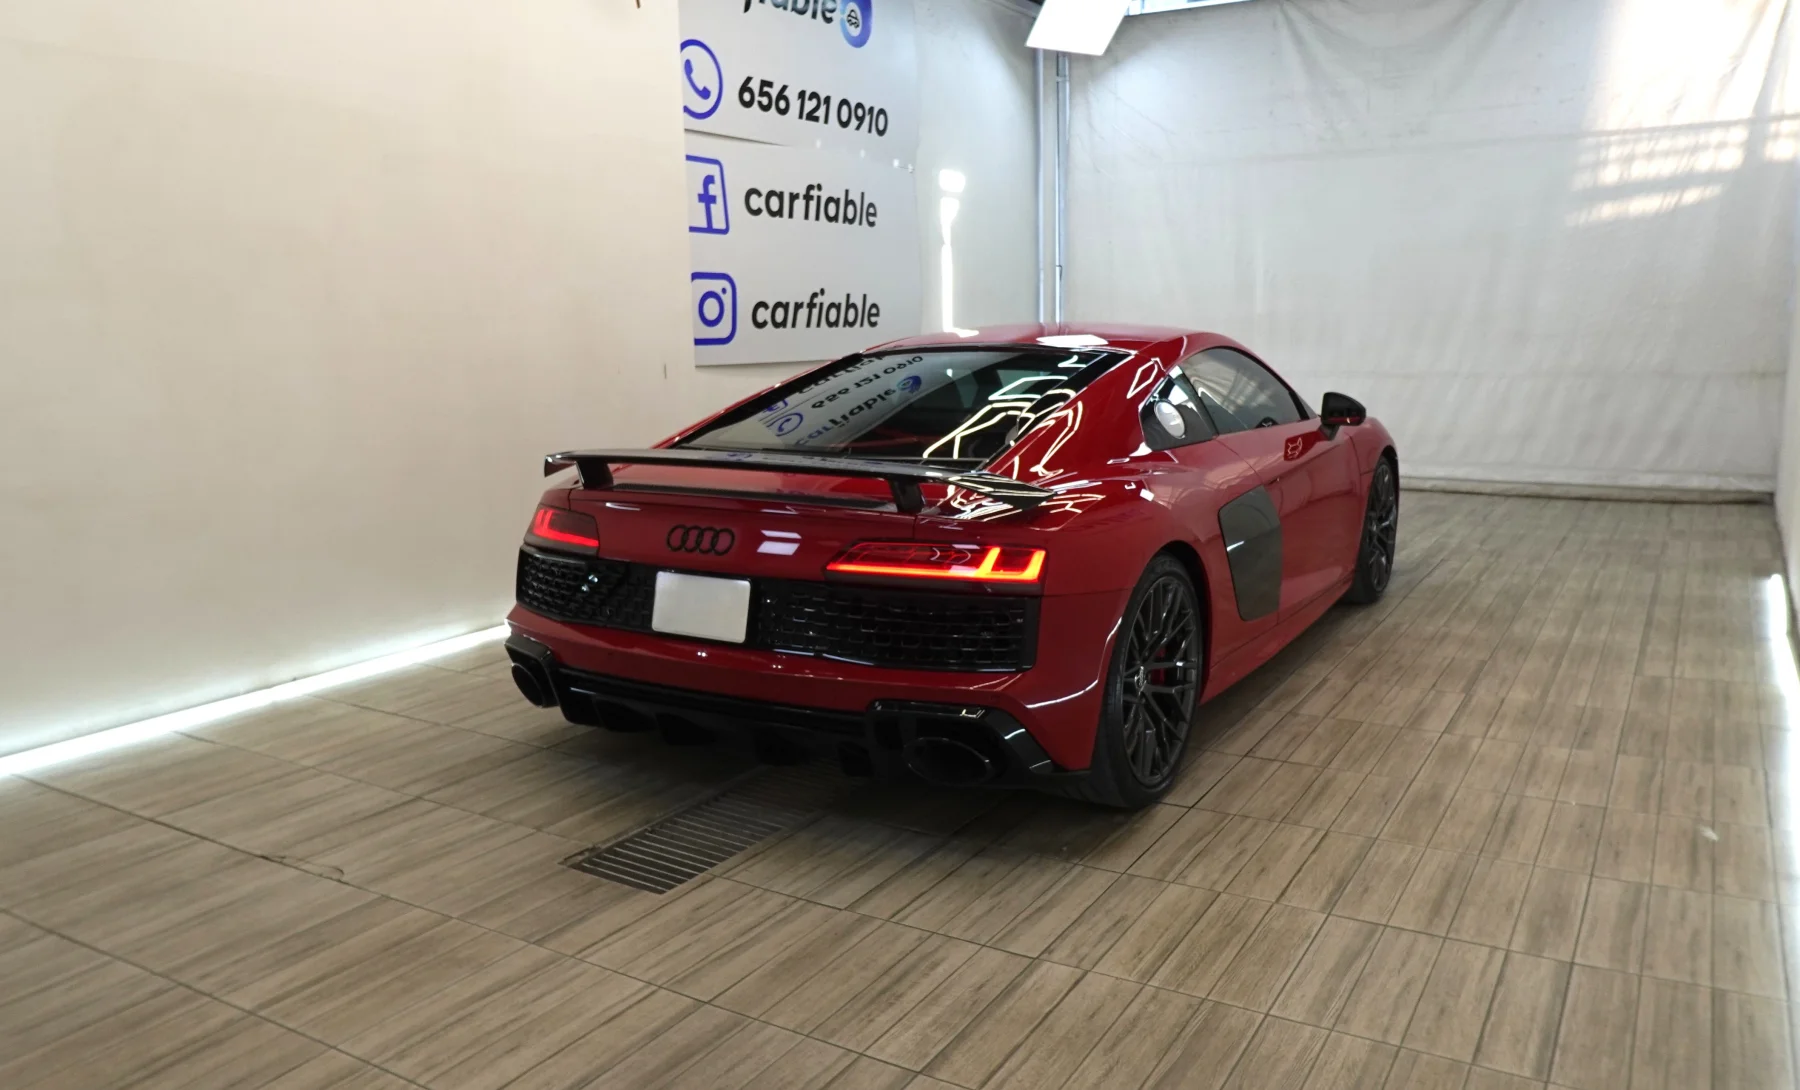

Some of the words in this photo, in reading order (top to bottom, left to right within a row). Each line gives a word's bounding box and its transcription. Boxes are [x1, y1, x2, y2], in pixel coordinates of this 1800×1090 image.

[738, 76, 790, 116] 656
[797, 90, 832, 125] 121
[836, 98, 889, 137] 0910
[744, 183, 878, 228] carfiable
[751, 287, 881, 330] carfiable
